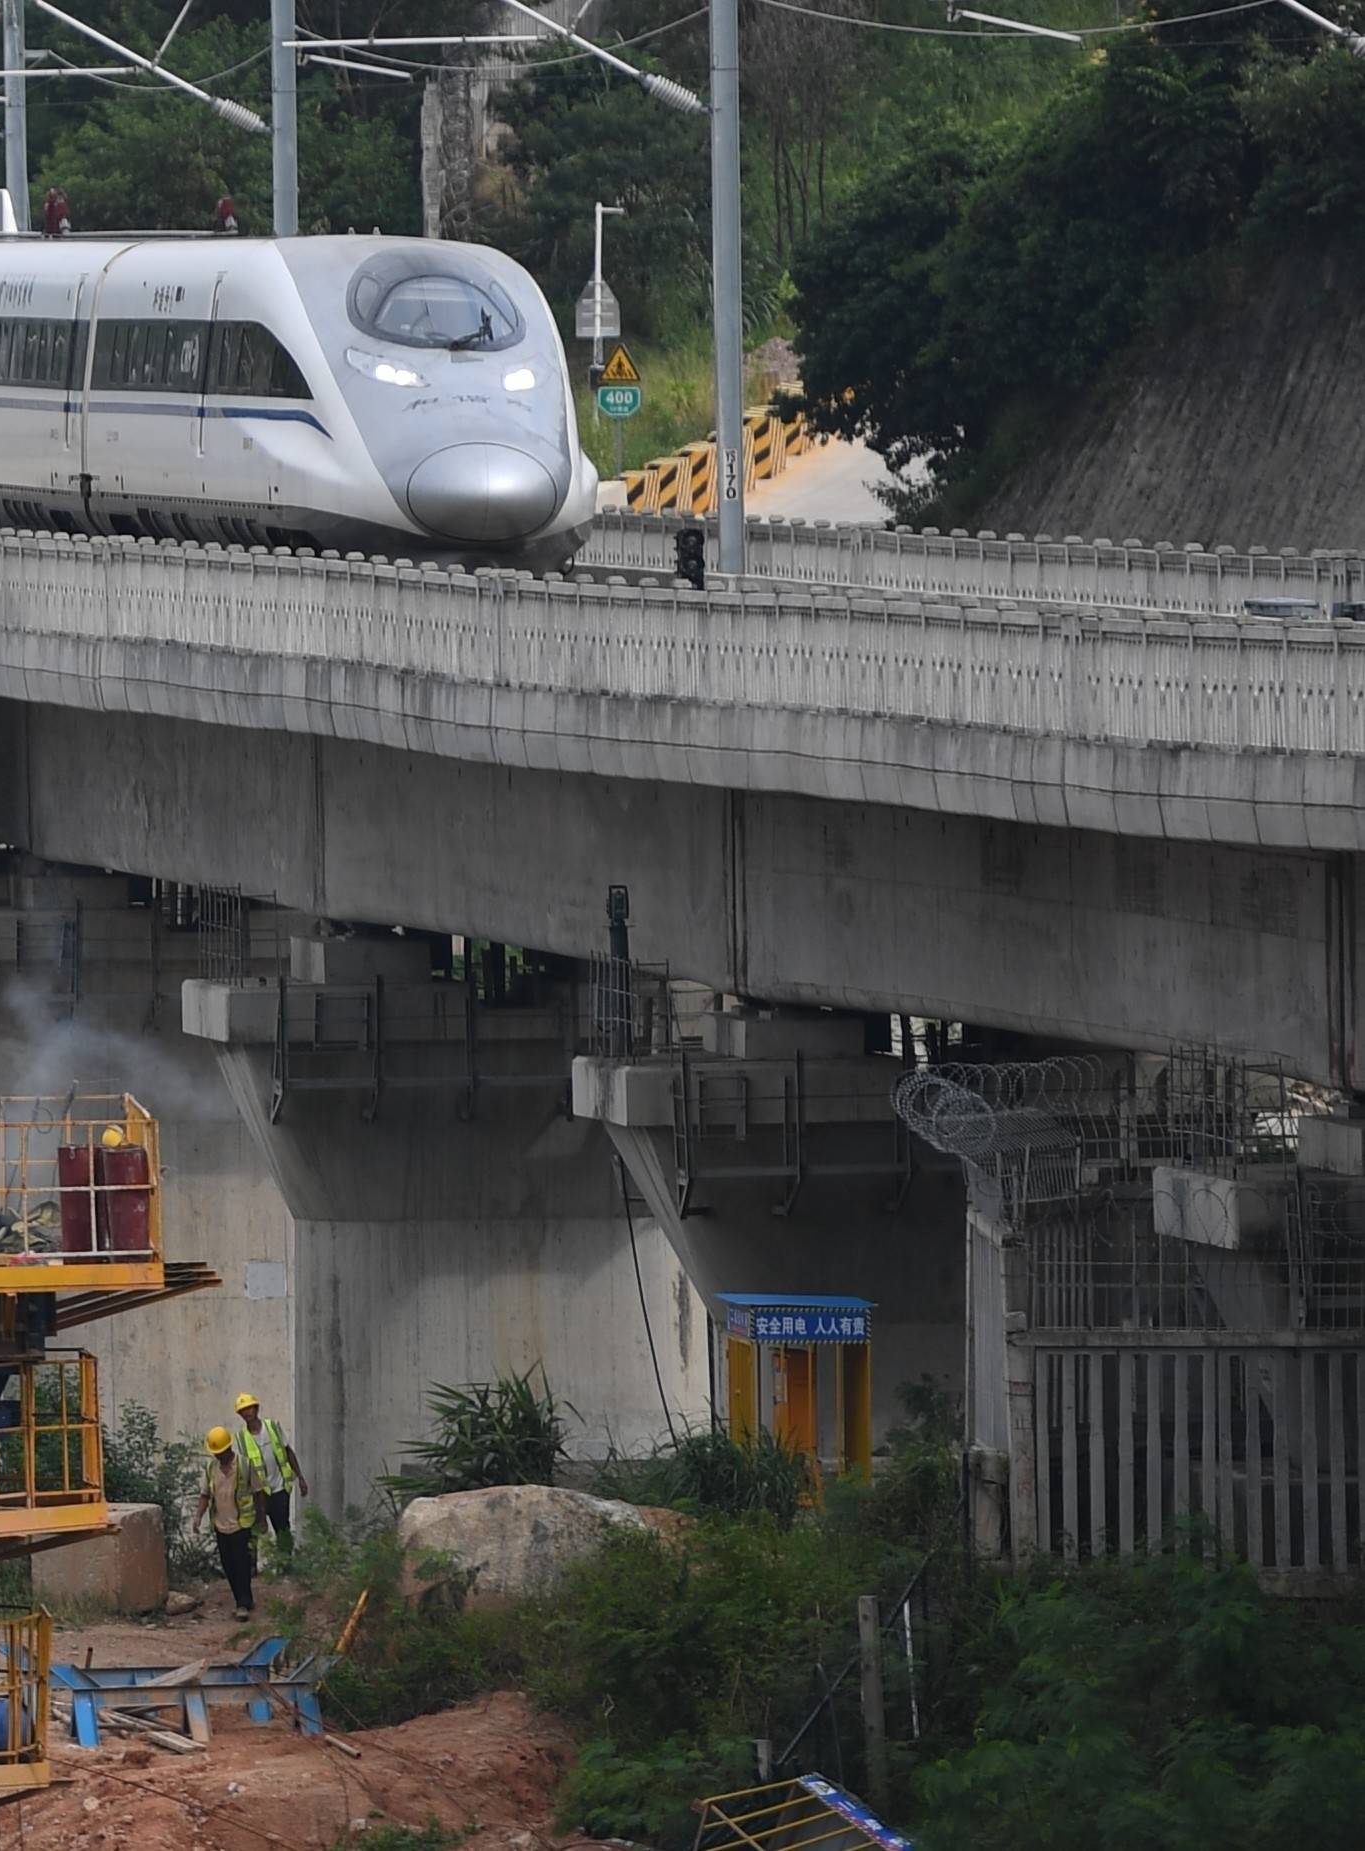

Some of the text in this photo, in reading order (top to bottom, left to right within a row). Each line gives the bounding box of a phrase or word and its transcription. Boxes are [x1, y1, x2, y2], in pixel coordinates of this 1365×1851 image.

[606, 390, 633, 404] 400
[756, 1316, 807, 1335] 安全用电
